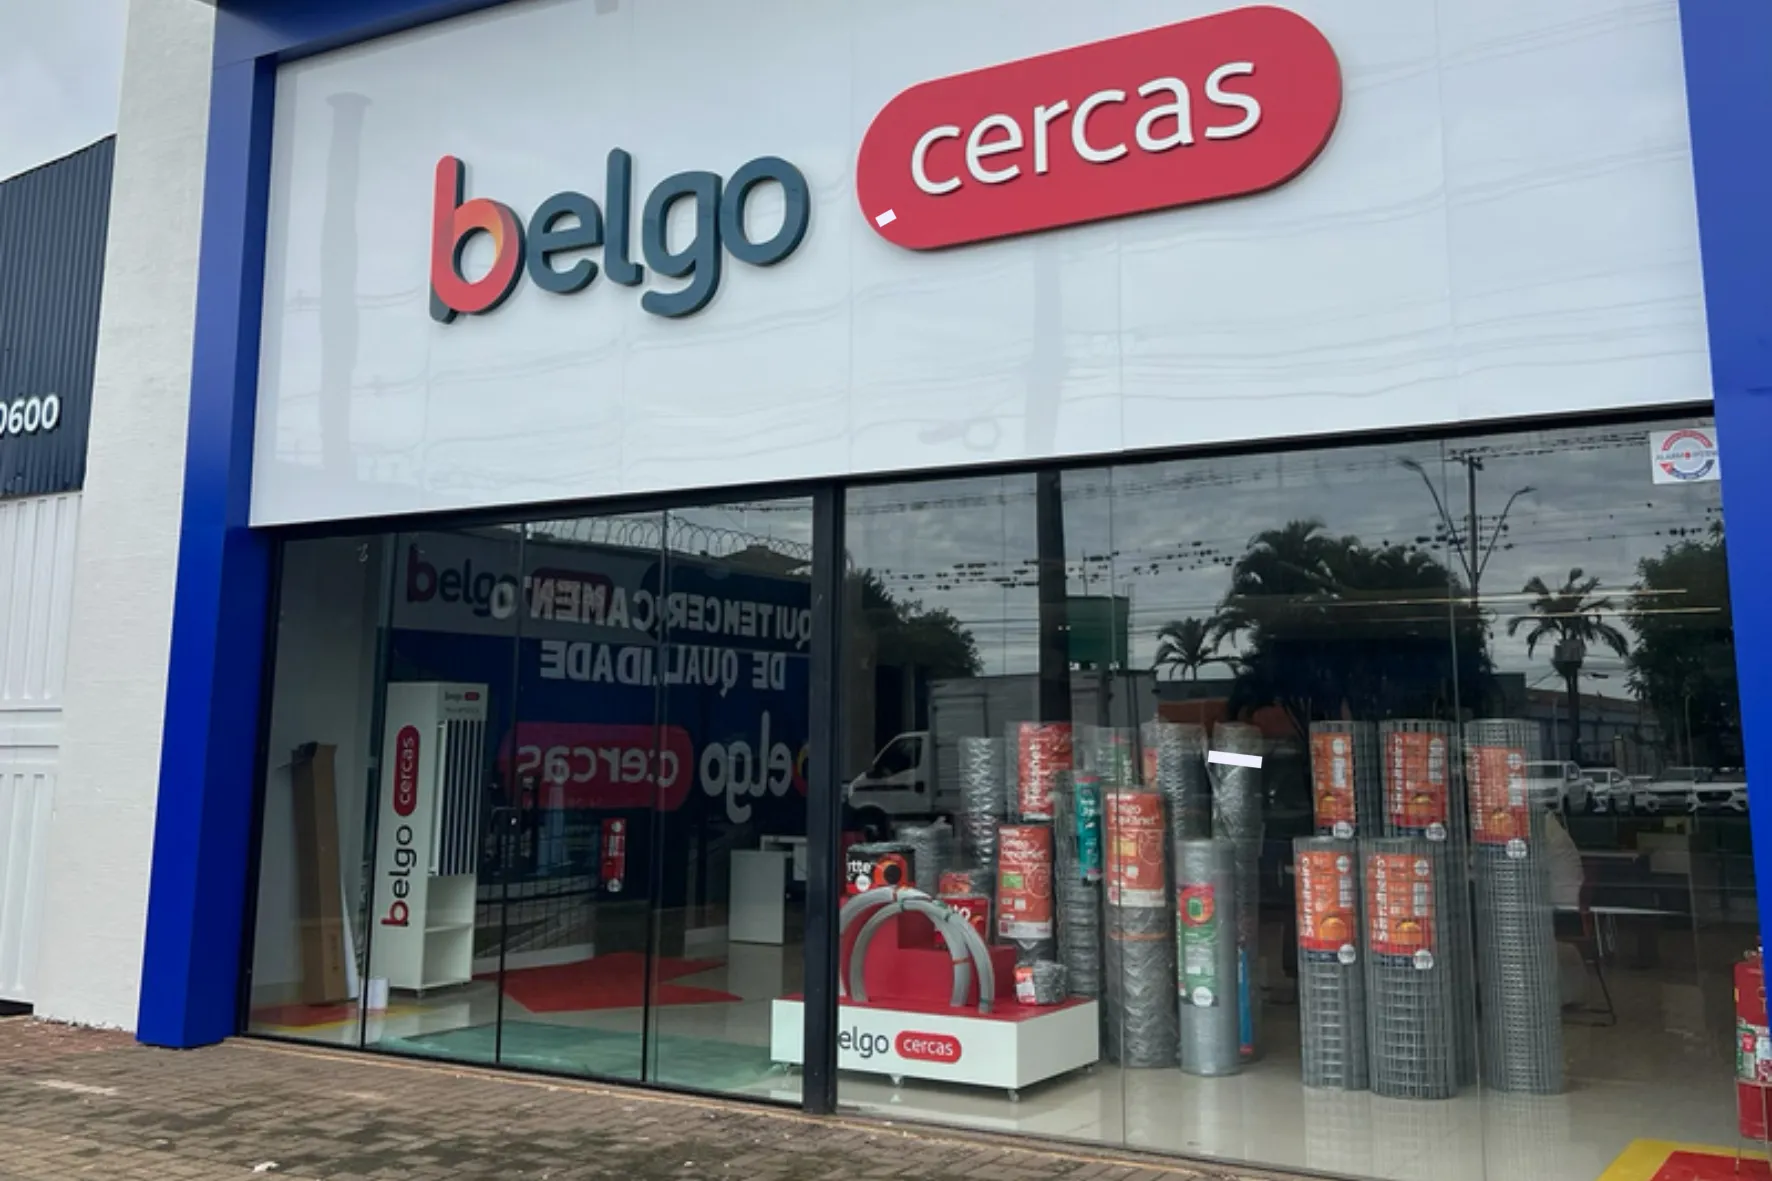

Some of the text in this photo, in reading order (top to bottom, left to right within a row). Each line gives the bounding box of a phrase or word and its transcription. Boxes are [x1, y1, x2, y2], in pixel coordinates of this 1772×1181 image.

[429, 61, 1262, 324] belgo cercas
[381, 736, 417, 928] belgo cercas
[837, 1026, 953, 1059] elgo cercas
